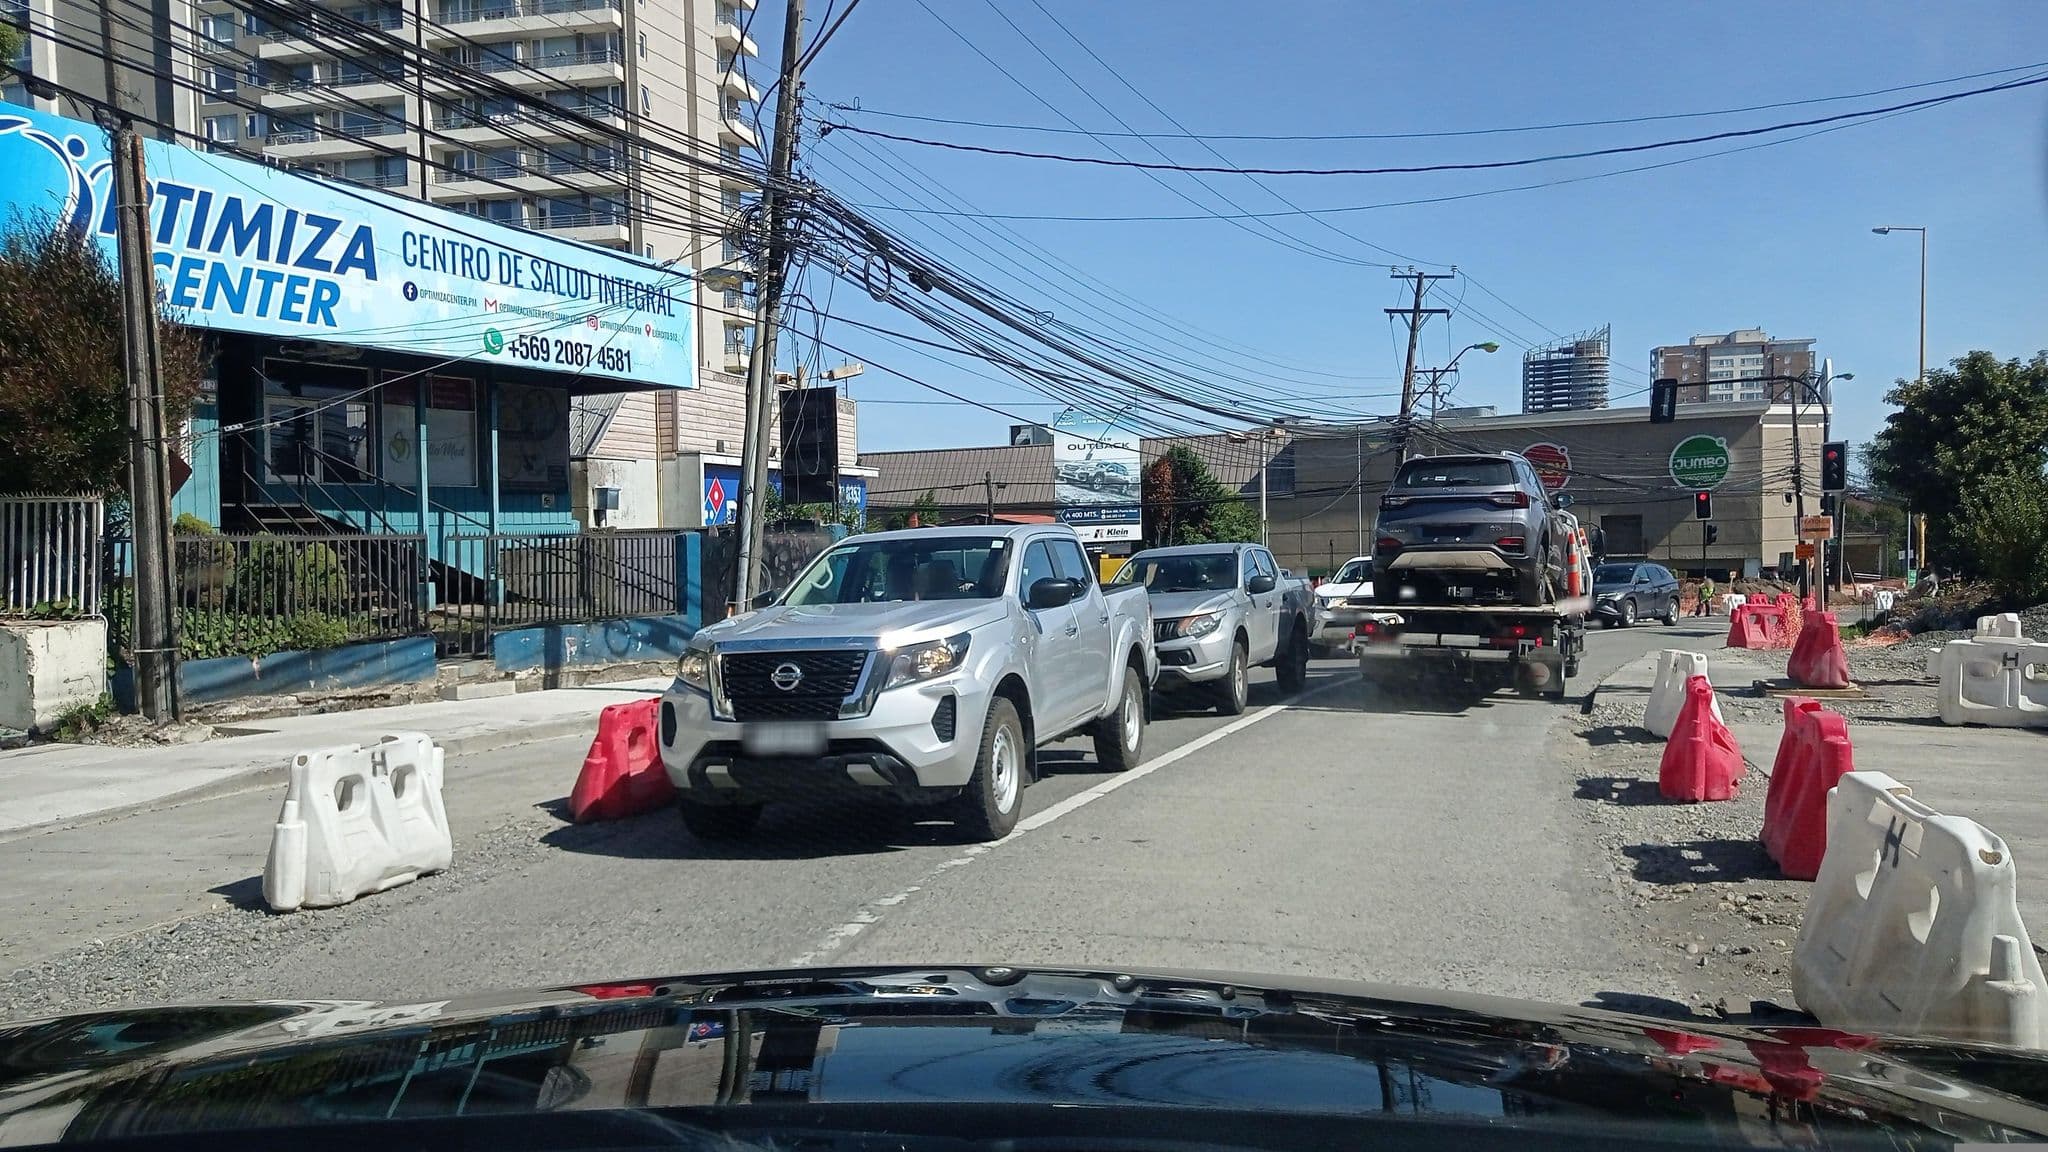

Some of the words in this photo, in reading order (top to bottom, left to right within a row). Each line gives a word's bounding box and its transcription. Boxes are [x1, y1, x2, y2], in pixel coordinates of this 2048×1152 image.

[402, 231, 490, 282] CENTRO
[499, 251, 524, 288] DE
[531, 259, 592, 301] SALUD
[599, 272, 676, 318] INTEGRAL
[508, 334, 550, 363] +569
[554, 340, 593, 368] 2087
[597, 346, 632, 373] 4581
[1067, 441, 1131, 451] OUTBACK
[1674, 456, 1727, 470] JUMBO
[1072, 511, 1083, 519] 400
[1106, 528, 1129, 536] Klein
[2002, 651, 2020, 668] H
[371, 750, 389, 778] H
[1881, 814, 1908, 869] H
